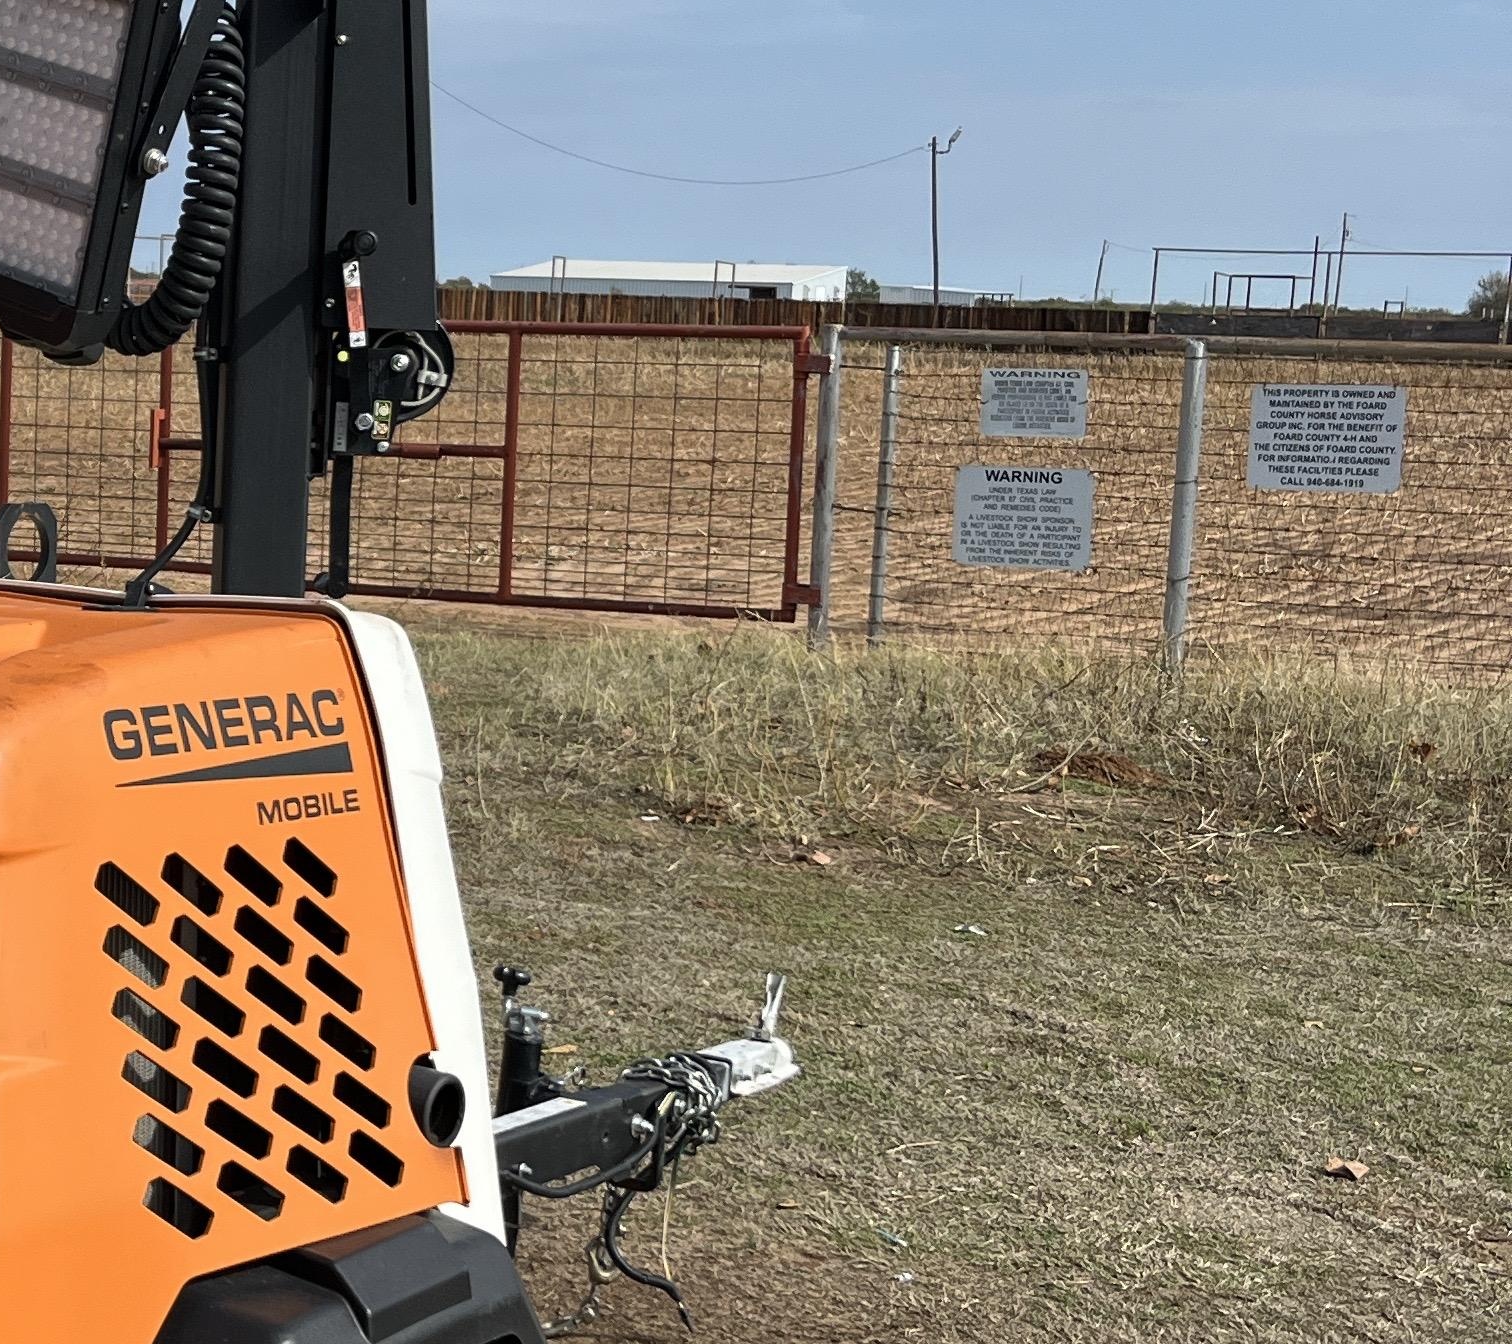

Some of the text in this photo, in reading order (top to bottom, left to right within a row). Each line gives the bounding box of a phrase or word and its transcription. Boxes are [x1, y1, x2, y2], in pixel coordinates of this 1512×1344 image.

[1263, 389, 1396, 399] THIS PROPERTY IS OWNED AND
[1269, 400, 1321, 408] MAINTAINED
[1323, 401, 1335, 409] BY
[1356, 402, 1387, 410] FOARD
[1270, 411, 1384, 420] COUNTY HORSE ADVISORY
[1289, 422, 1305, 430] INC.
[1328, 423, 1344, 431] THE
[1347, 424, 1383, 432] BENEFIT
[1274, 433, 1303, 441] FOARD
[1306, 434, 1340, 442] COUNTY
[1359, 435, 1377, 443] AND
[1254, 443, 1270, 451] THE
[1273, 444, 1310, 452] CITIZENS
[1327, 445, 1356, 453] FOARD
[1359, 446, 1396, 454] COUNTY.
[1258, 454, 1275, 462] FOR
[1339, 457, 1390, 465] REGARDING
[1268, 465, 1379, 476] THESE FACILITIES PLEASE
[985, 470, 1063, 484] WARNING
[1280, 478, 1304, 486] CALL
[1040, 497, 1073, 505] PRACTICE
[1001, 504, 1035, 512] REMEDIES
[1043, 542, 1080, 550] RESULTING
[103, 689, 344, 760] GENERAC
[256, 789, 360, 826] MOBILE
